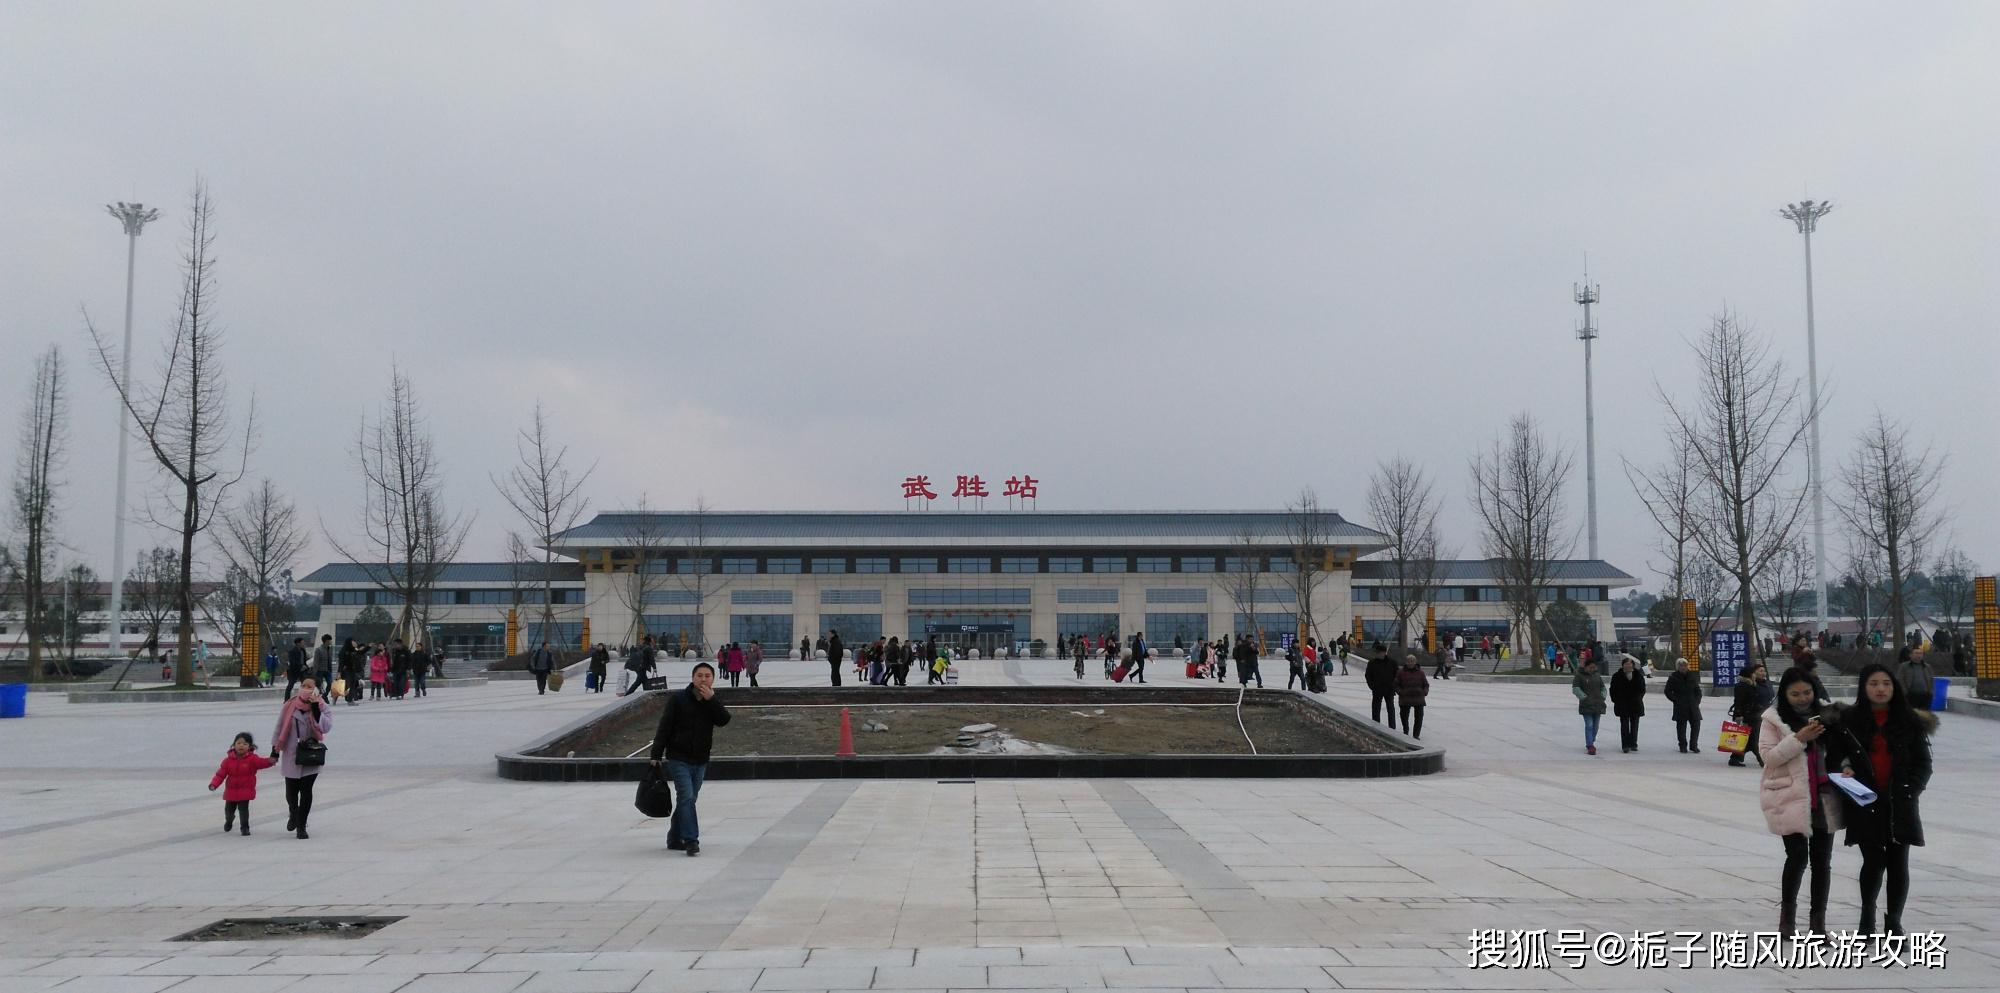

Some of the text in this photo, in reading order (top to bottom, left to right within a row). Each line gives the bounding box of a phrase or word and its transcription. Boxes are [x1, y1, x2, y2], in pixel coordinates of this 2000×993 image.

[902, 475, 1039, 499] 武胜站
[1716, 634, 1730, 684] 禁止摆摊设点
